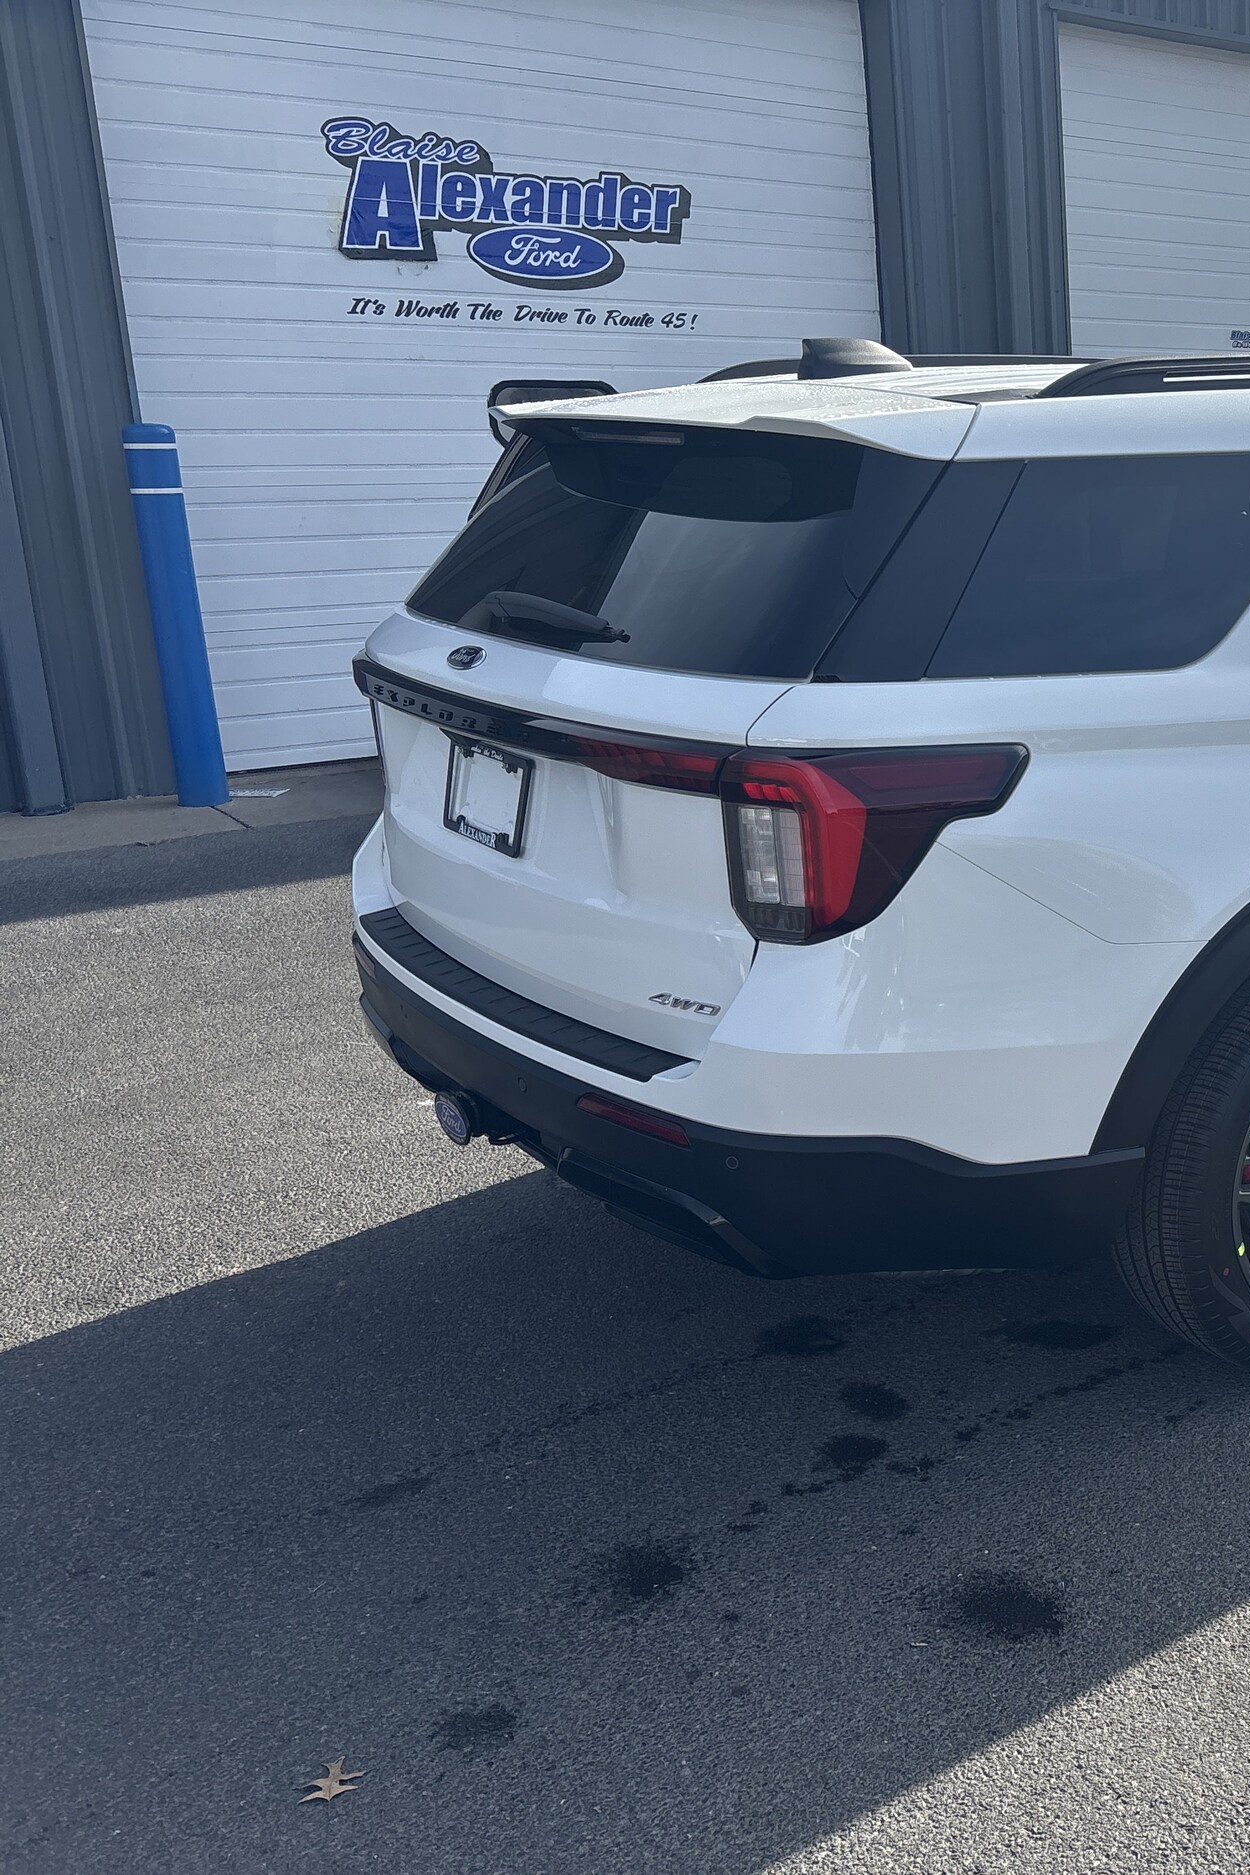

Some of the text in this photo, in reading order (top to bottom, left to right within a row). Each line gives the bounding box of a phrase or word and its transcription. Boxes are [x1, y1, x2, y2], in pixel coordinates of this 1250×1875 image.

[324, 119, 480, 164] Blaise
[342, 156, 680, 251] Alexander
[504, 233, 582, 270] Ford
[346, 297, 386, 317] It's
[394, 298, 460, 321] Worth
[467, 302, 504, 323] The
[513, 304, 568, 325] Drive
[574, 307, 597, 326] To
[603, 309, 655, 329] Route
[458, 819, 497, 849] ALEXANDER
[647, 991, 722, 1017] 4WD
